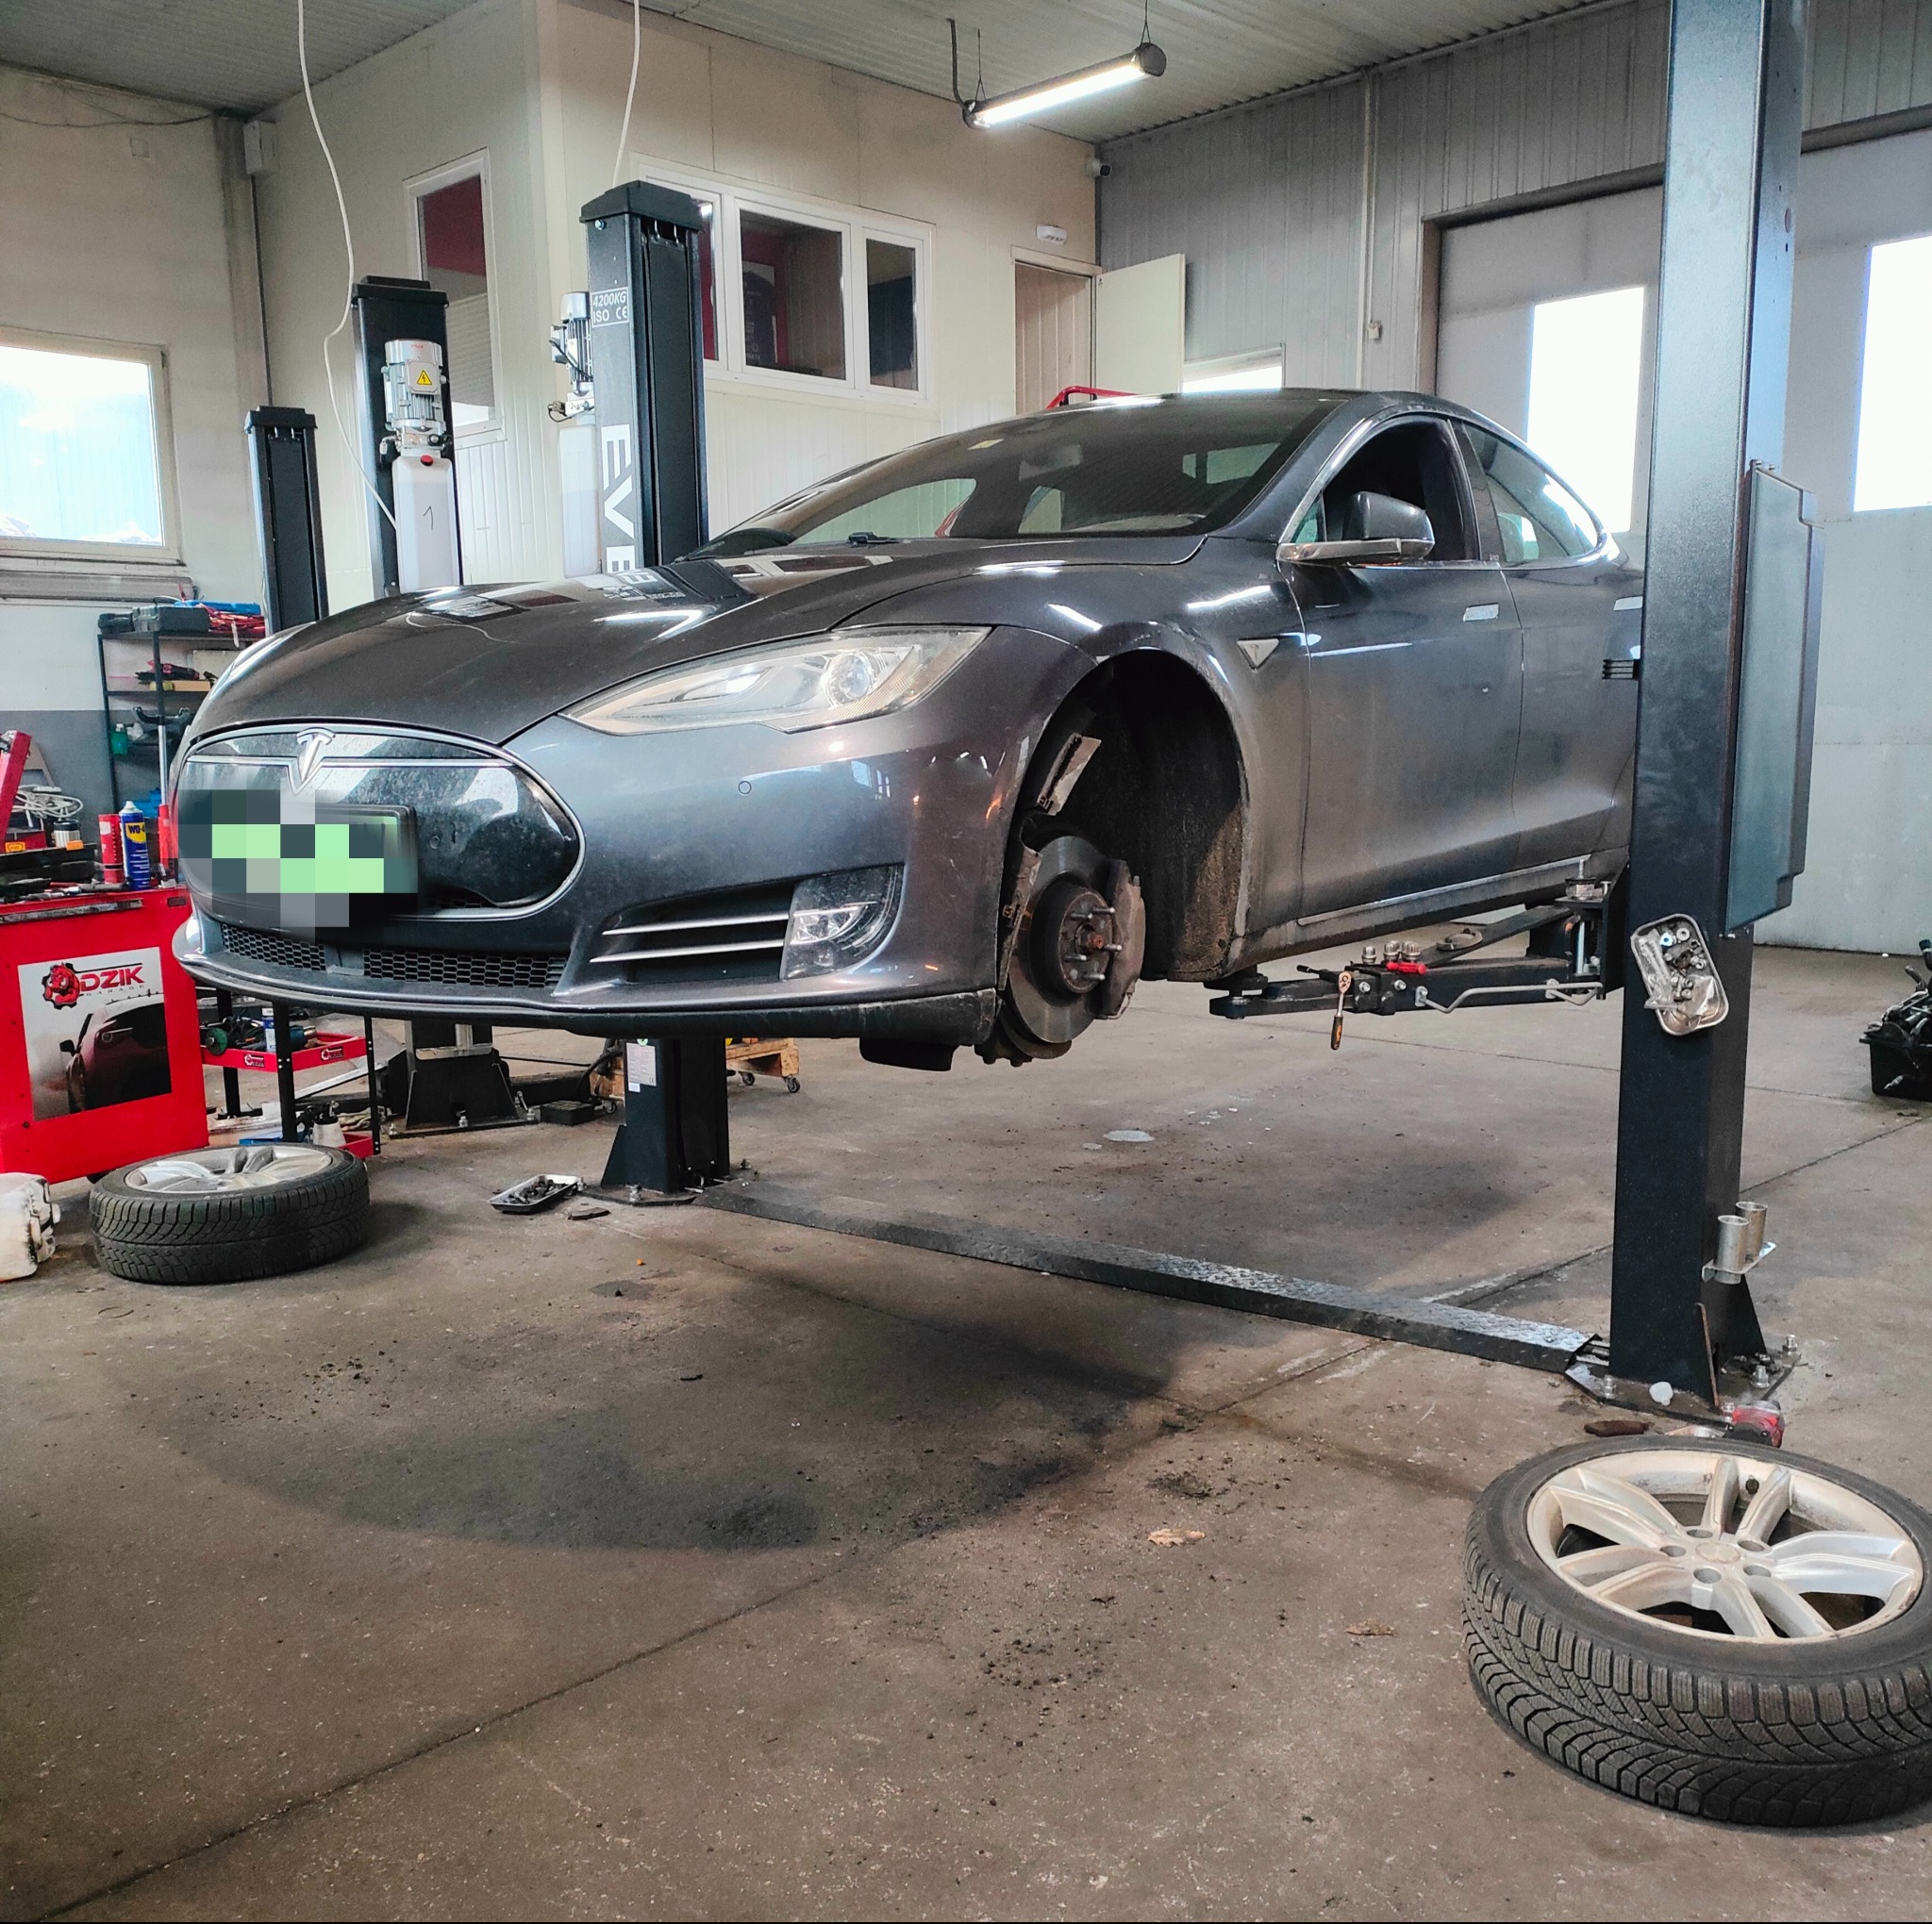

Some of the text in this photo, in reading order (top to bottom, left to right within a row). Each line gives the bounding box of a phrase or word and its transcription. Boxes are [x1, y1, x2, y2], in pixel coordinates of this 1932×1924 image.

[592, 290, 626, 307] 4200KG
[593, 306, 627, 323] ISO CE
[79, 966, 145, 992] DZIK
[86, 985, 145, 998] GARAGE
